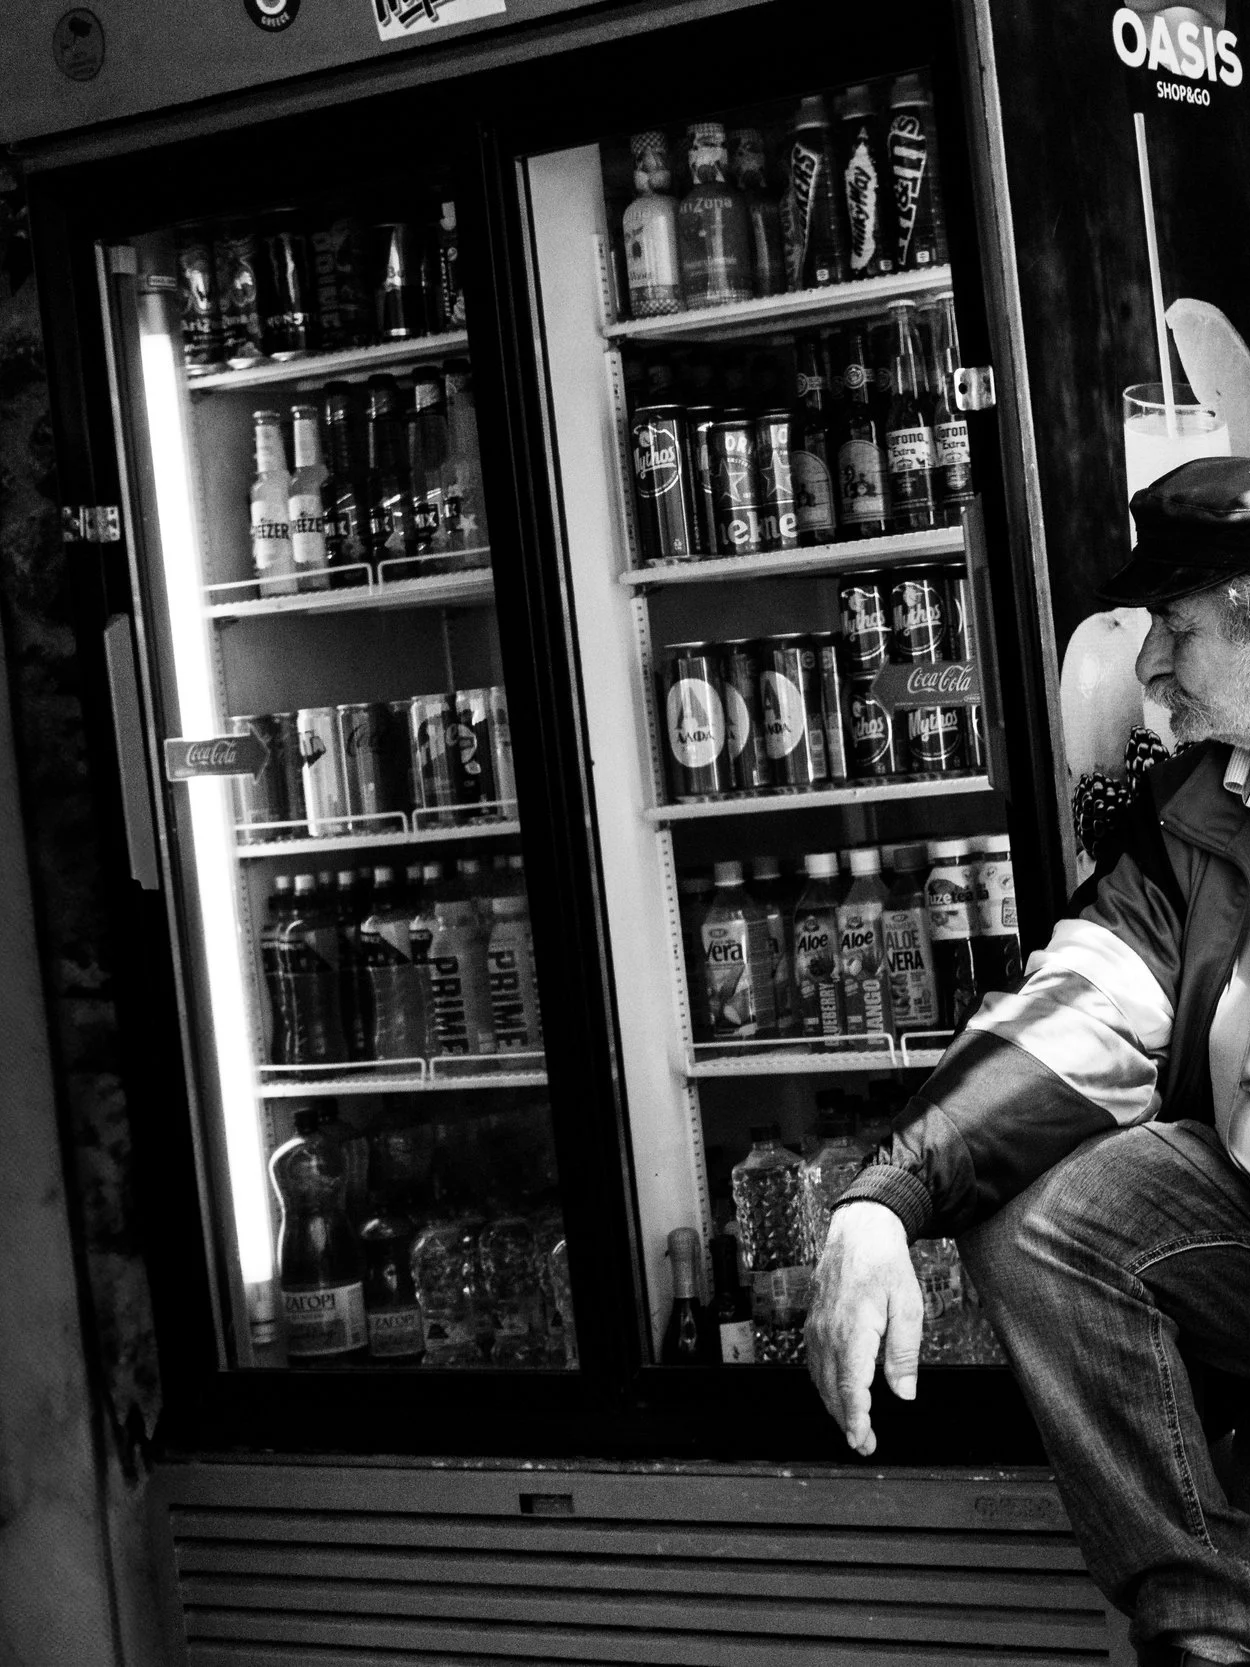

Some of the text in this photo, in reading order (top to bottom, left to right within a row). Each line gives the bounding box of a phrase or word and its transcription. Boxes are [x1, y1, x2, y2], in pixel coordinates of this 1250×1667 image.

[1112, 7, 1243, 87] OASIS
[1156, 81, 1211, 106] SHOP&GO
[935, 426, 968, 443] Coron
[909, 708, 958, 742] Mythos
[799, 933, 828, 951] Aloe
[841, 930, 874, 949] Aloe
[886, 929, 921, 950] ALOE
[887, 950, 924, 973] VERA
[430, 955, 469, 1054] PRIME
[492, 949, 529, 1048] PRIME
[819, 983, 840, 1047] BUEBERRY
